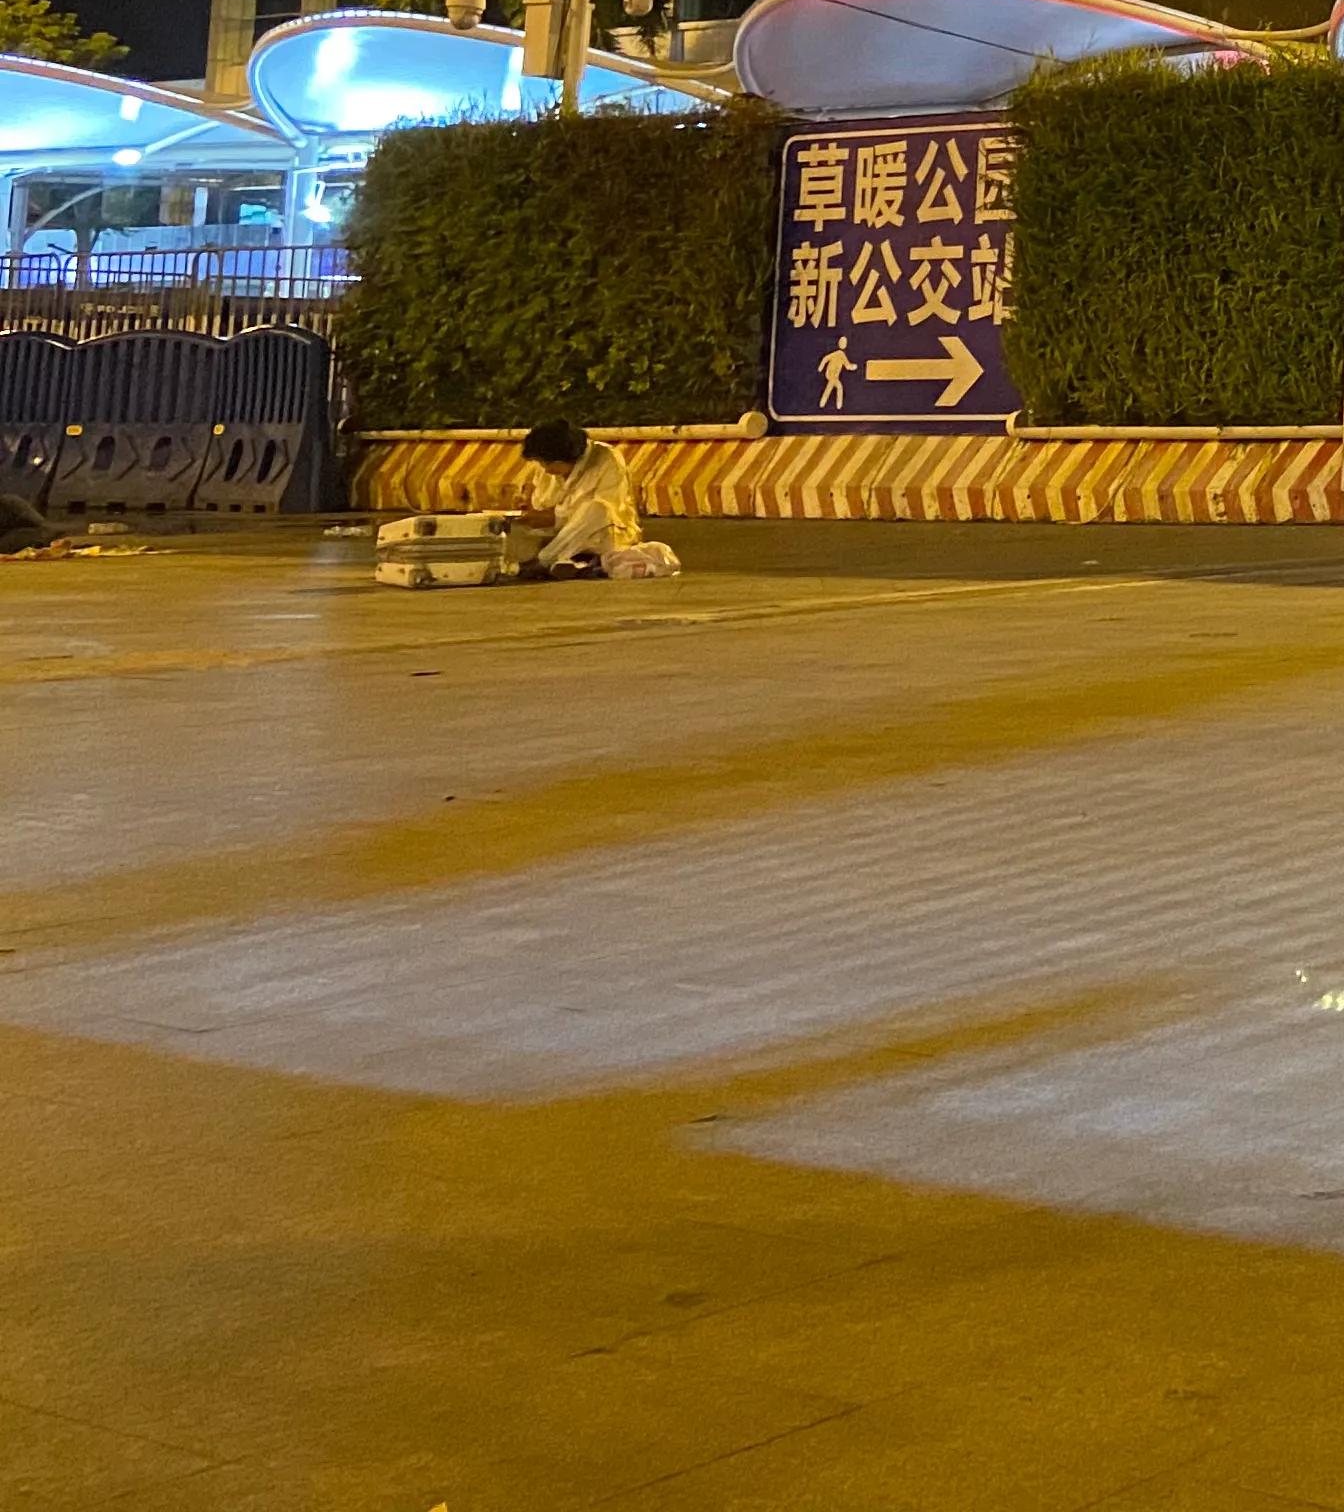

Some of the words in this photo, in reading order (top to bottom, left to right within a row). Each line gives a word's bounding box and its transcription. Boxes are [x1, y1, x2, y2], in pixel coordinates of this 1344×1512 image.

[793, 137, 1020, 232] 草暖公园
[787, 232, 1015, 329] 新公交站
